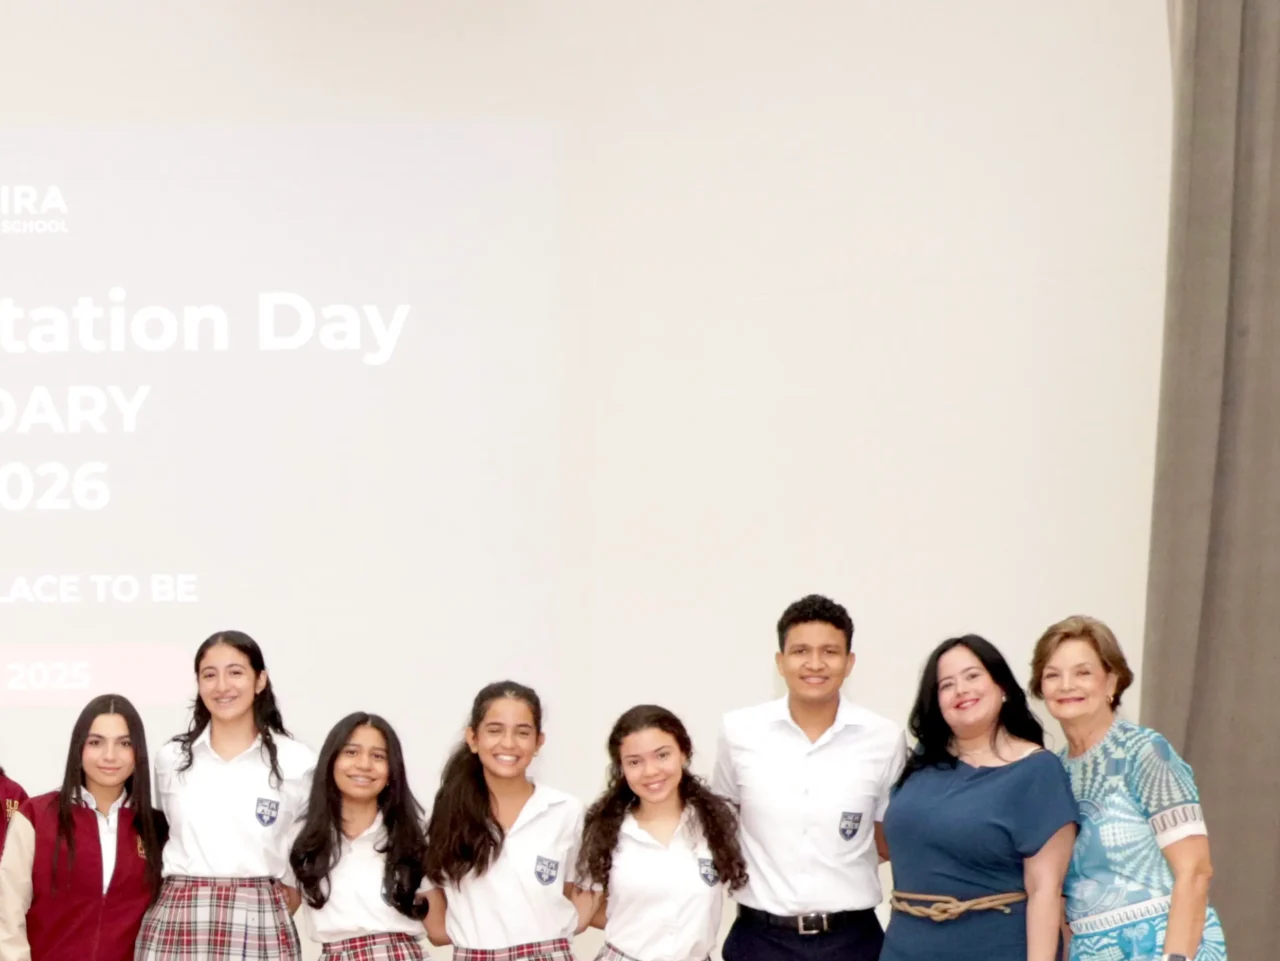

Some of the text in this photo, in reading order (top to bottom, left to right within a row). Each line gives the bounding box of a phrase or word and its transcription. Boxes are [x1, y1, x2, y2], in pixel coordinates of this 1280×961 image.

[1, 218, 70, 234] SCHOOL
[258, 291, 411, 366] Day
[89, 574, 141, 604] TO
[150, 573, 199, 603] BE
[4, 660, 92, 691] 2025
